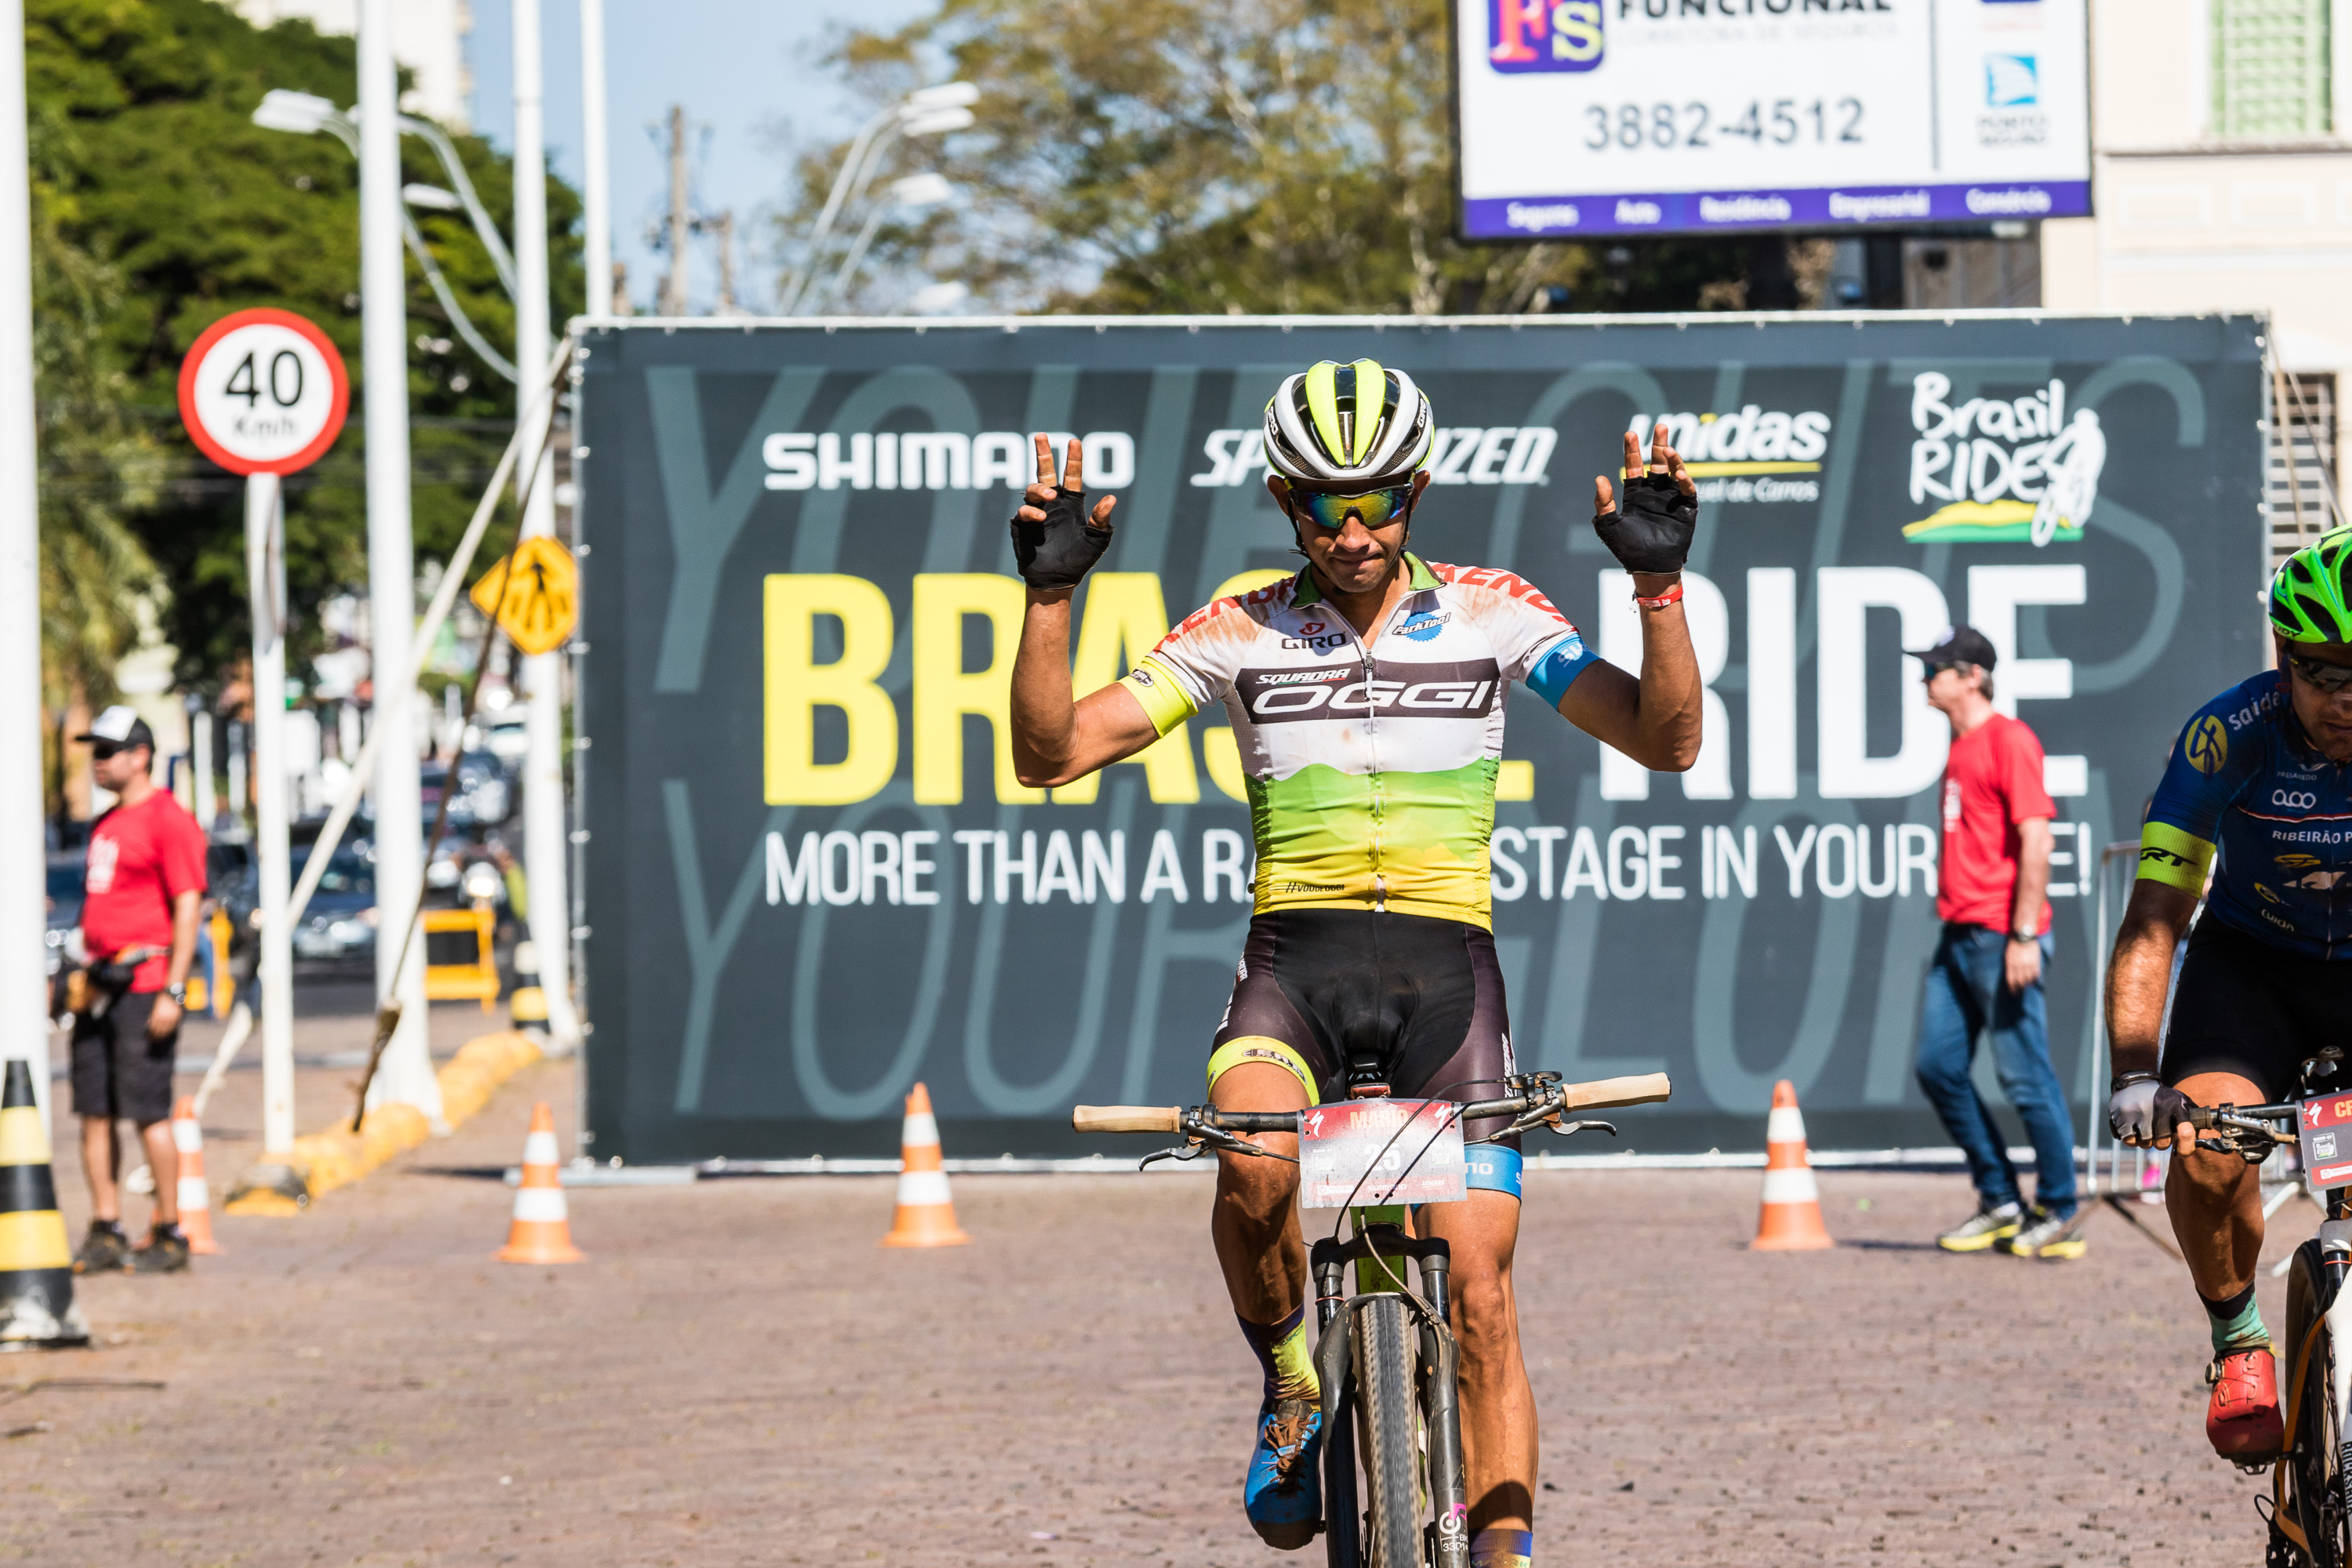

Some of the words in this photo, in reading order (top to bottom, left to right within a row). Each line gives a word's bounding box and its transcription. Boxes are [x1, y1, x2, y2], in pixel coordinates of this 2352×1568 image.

[1583, 96, 1866, 151] 3882-4512
[224, 350, 304, 408] 40
[1911, 371, 2066, 443] Brasil
[1189, 429, 1559, 487] SPIZED
[1281, 633, 1347, 650] GIRO
[763, 572, 1535, 806] BRA
[1252, 680, 1492, 715] OGGI
[1255, 668, 1351, 686] SQUADRA
[1490, 825, 1687, 902] STAGE
[1702, 824, 1758, 899] IN
[1773, 823, 1938, 898] YOUR
[2272, 829, 2341, 844] RIBEIRÃO
[764, 829, 941, 906] MORE
[953, 828, 1127, 905] THAN
[1140, 828, 1189, 904] A
[1349, 1109, 1409, 1130] MARIO
[1364, 1143, 1402, 1172] 25
